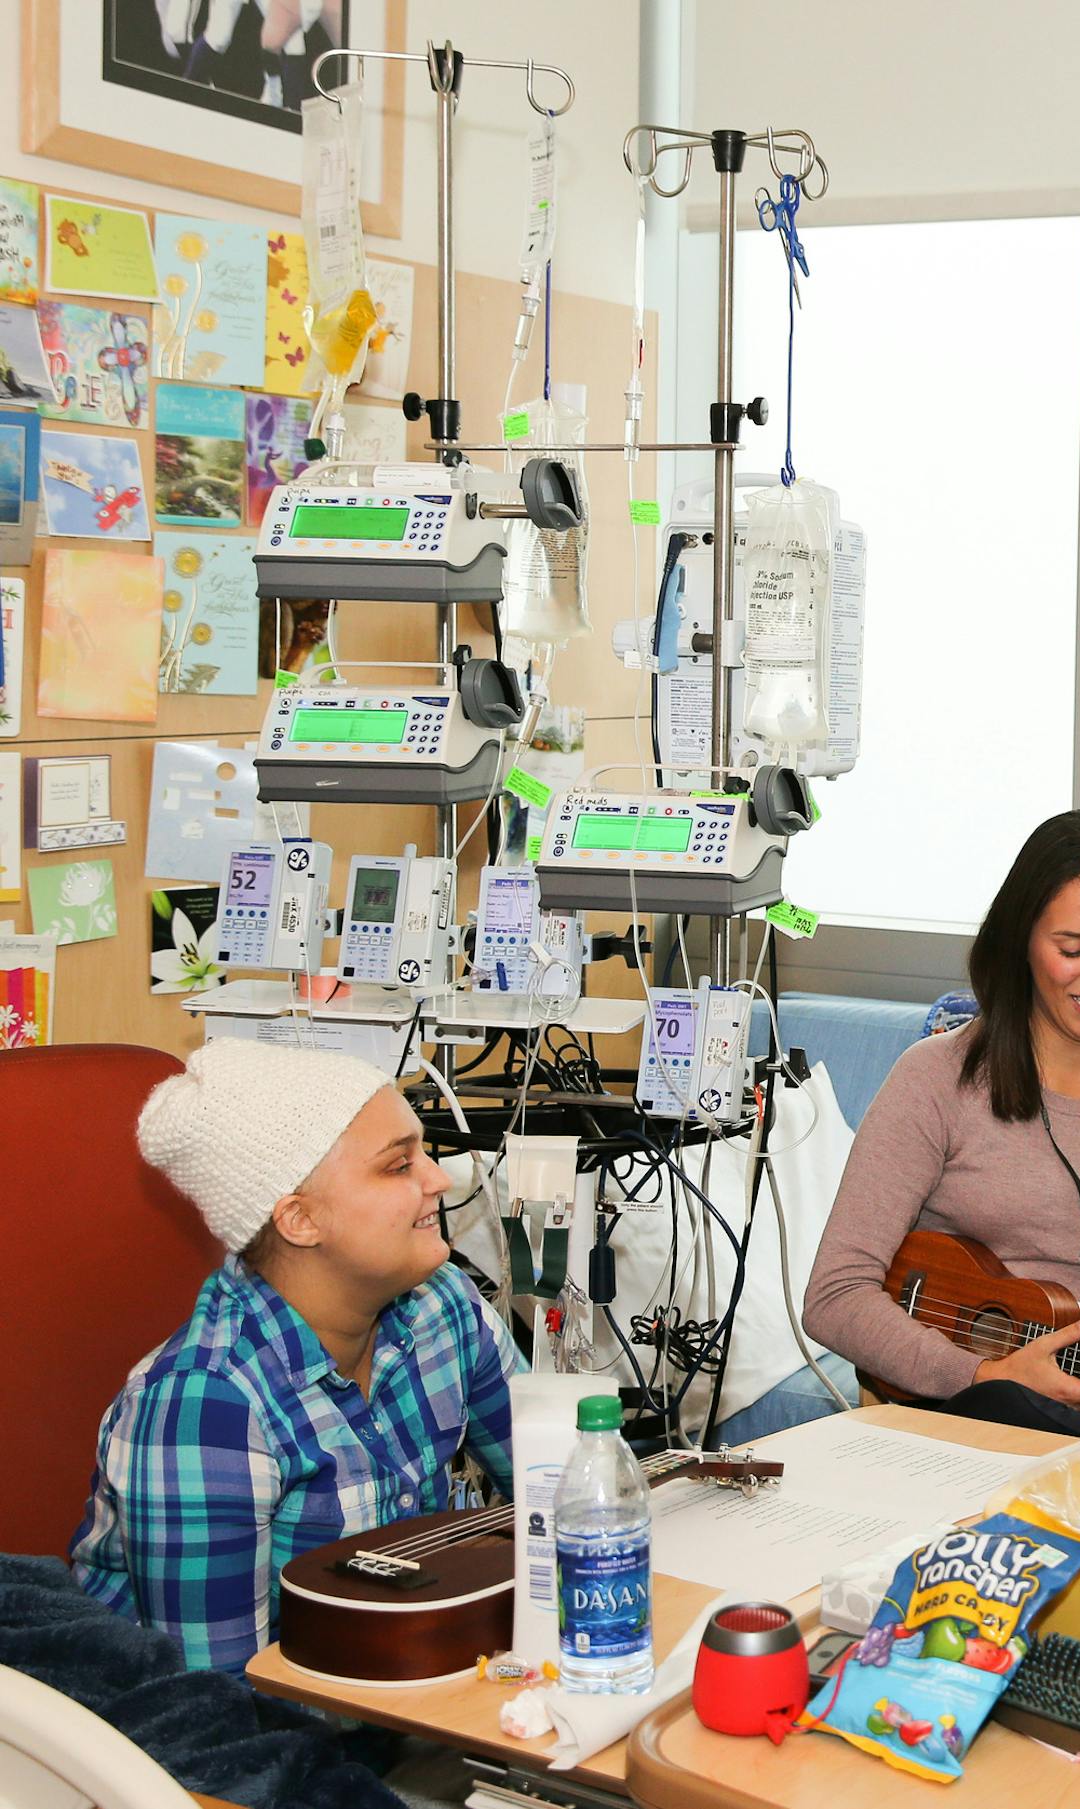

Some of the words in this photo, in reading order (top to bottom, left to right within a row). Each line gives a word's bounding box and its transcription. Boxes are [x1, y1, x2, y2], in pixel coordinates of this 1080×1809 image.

[778, 591, 794, 600] USP
[231, 869, 257, 890] 52
[656, 1018, 680, 1038] 70
[918, 1532, 1041, 1576] JOLLY
[920, 1558, 1032, 1603] rancher
[954, 1593, 1010, 1632] CADY
